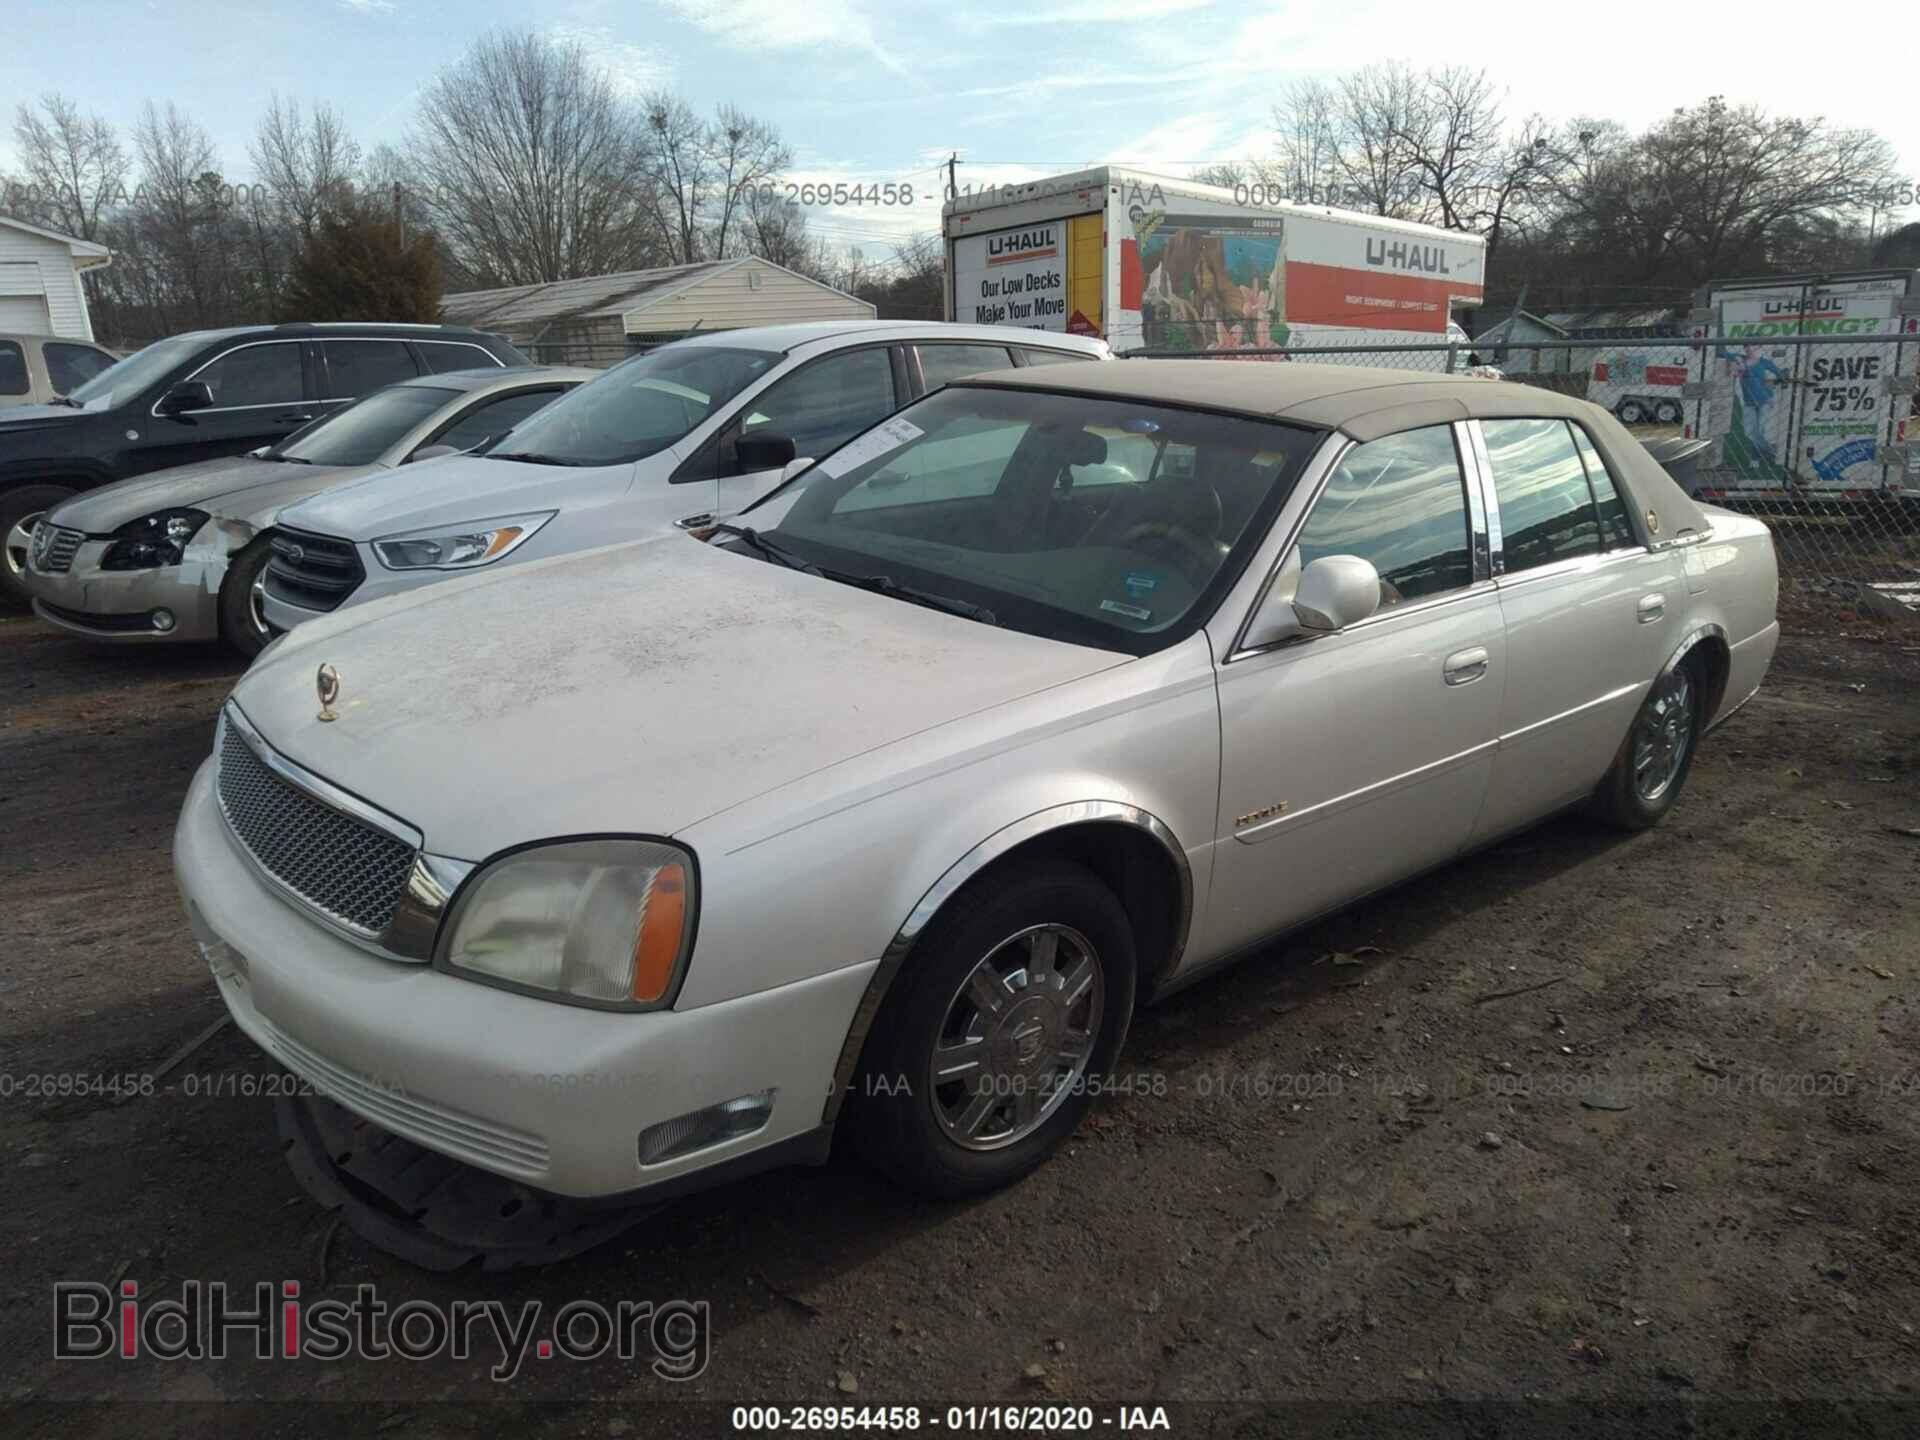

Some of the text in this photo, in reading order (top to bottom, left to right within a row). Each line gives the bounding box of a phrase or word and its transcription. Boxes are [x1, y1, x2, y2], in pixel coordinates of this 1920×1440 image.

[989, 229, 1055, 255] U-HAUL
[1366, 237, 1449, 274] U-HAUL
[981, 270, 1060, 298] Our Low Decks
[976, 297, 1064, 324] Make Your Move
[1764, 298, 1843, 314] U-HAUL
[1727, 317, 1881, 338] MOVING?
[1812, 356, 1880, 381] SAVE
[1812, 386, 1875, 412] 75%
